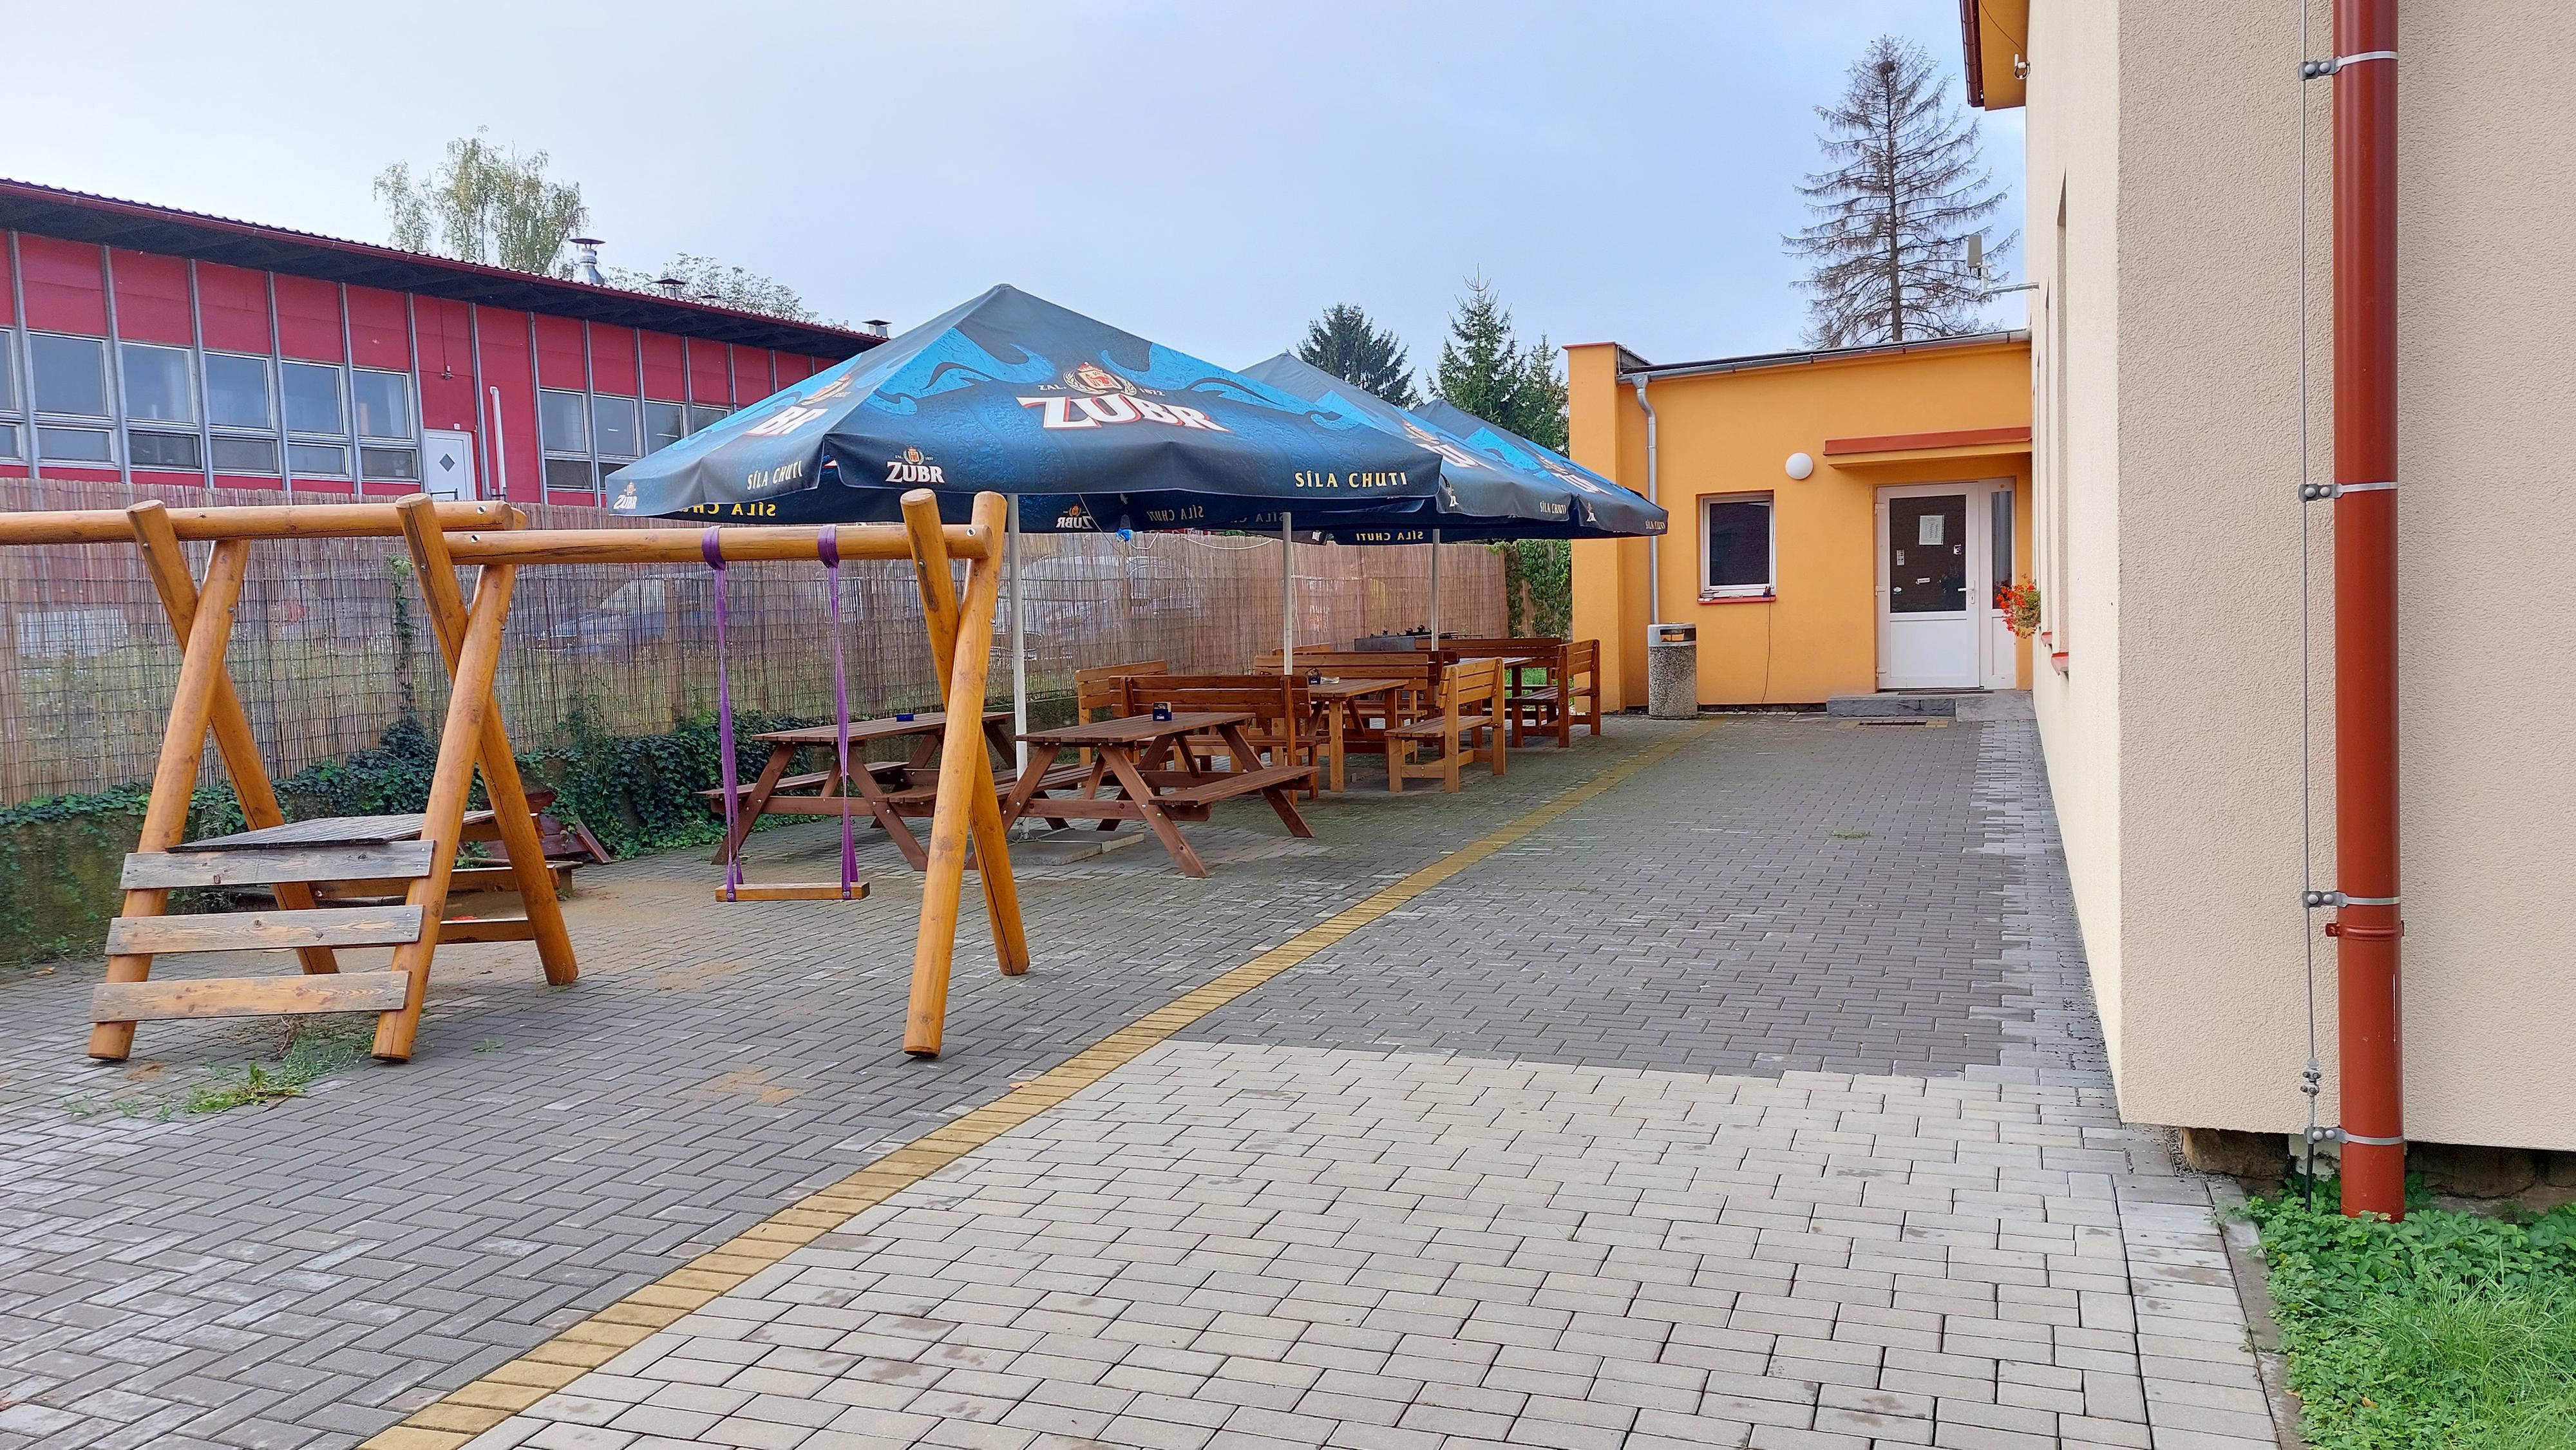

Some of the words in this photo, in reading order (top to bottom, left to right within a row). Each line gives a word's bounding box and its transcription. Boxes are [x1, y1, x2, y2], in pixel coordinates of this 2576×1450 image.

[744, 406, 829, 437] BR
[1016, 393, 1231, 433] ZUBR
[747, 470, 768, 490] SÍLA
[773, 460, 802, 484] CHUTI
[886, 461, 945, 484] ZUBR
[1294, 470, 1338, 487] SÍLA
[1349, 471, 1407, 488] CHUTI
[613, 494, 638, 509] ZUBR
